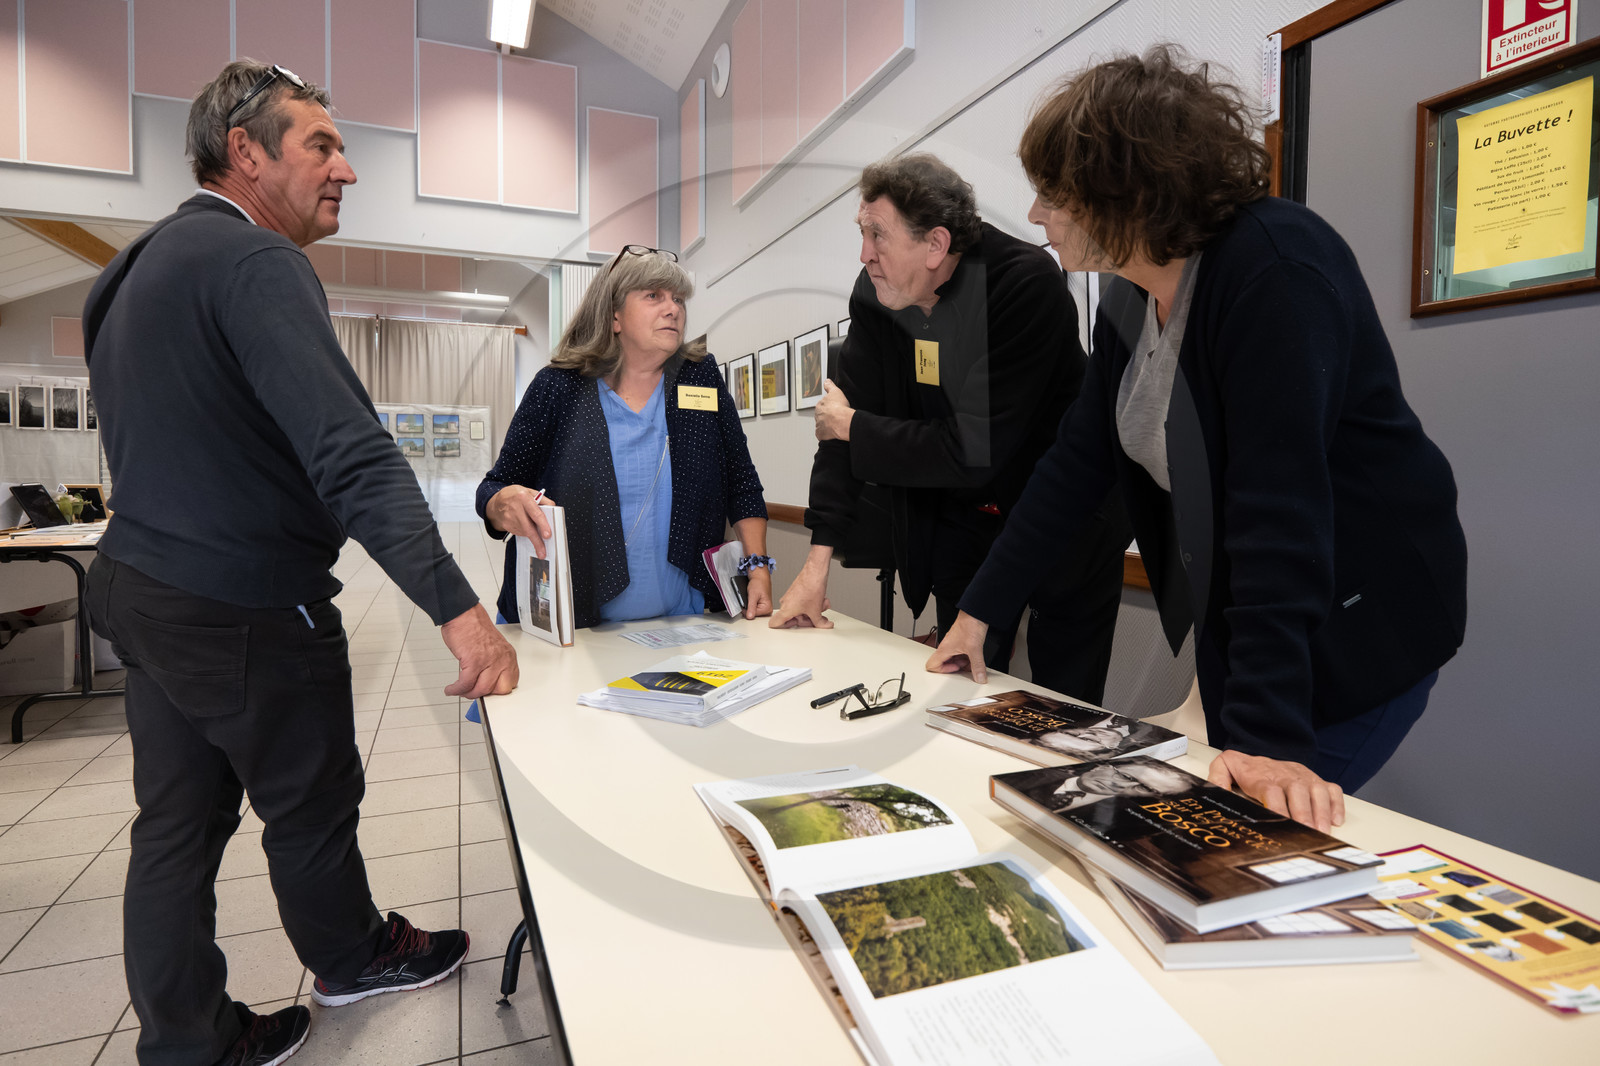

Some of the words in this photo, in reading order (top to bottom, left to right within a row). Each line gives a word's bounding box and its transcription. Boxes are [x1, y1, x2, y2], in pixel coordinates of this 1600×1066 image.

[1499, 19, 1558, 48] Extincteur
[1495, 53, 1502, 62] à
[1506, 31, 1561, 58] l'interieur
[1474, 137, 1491, 149] La
[1497, 117, 1561, 143] Buvette
[1567, 109, 1573, 122] !
[1508, 153, 1529, 161] Infusion
[1522, 171, 1545, 180] Limonade
[1168, 800, 1192, 813] sur
[1180, 798, 1203, 810] En
